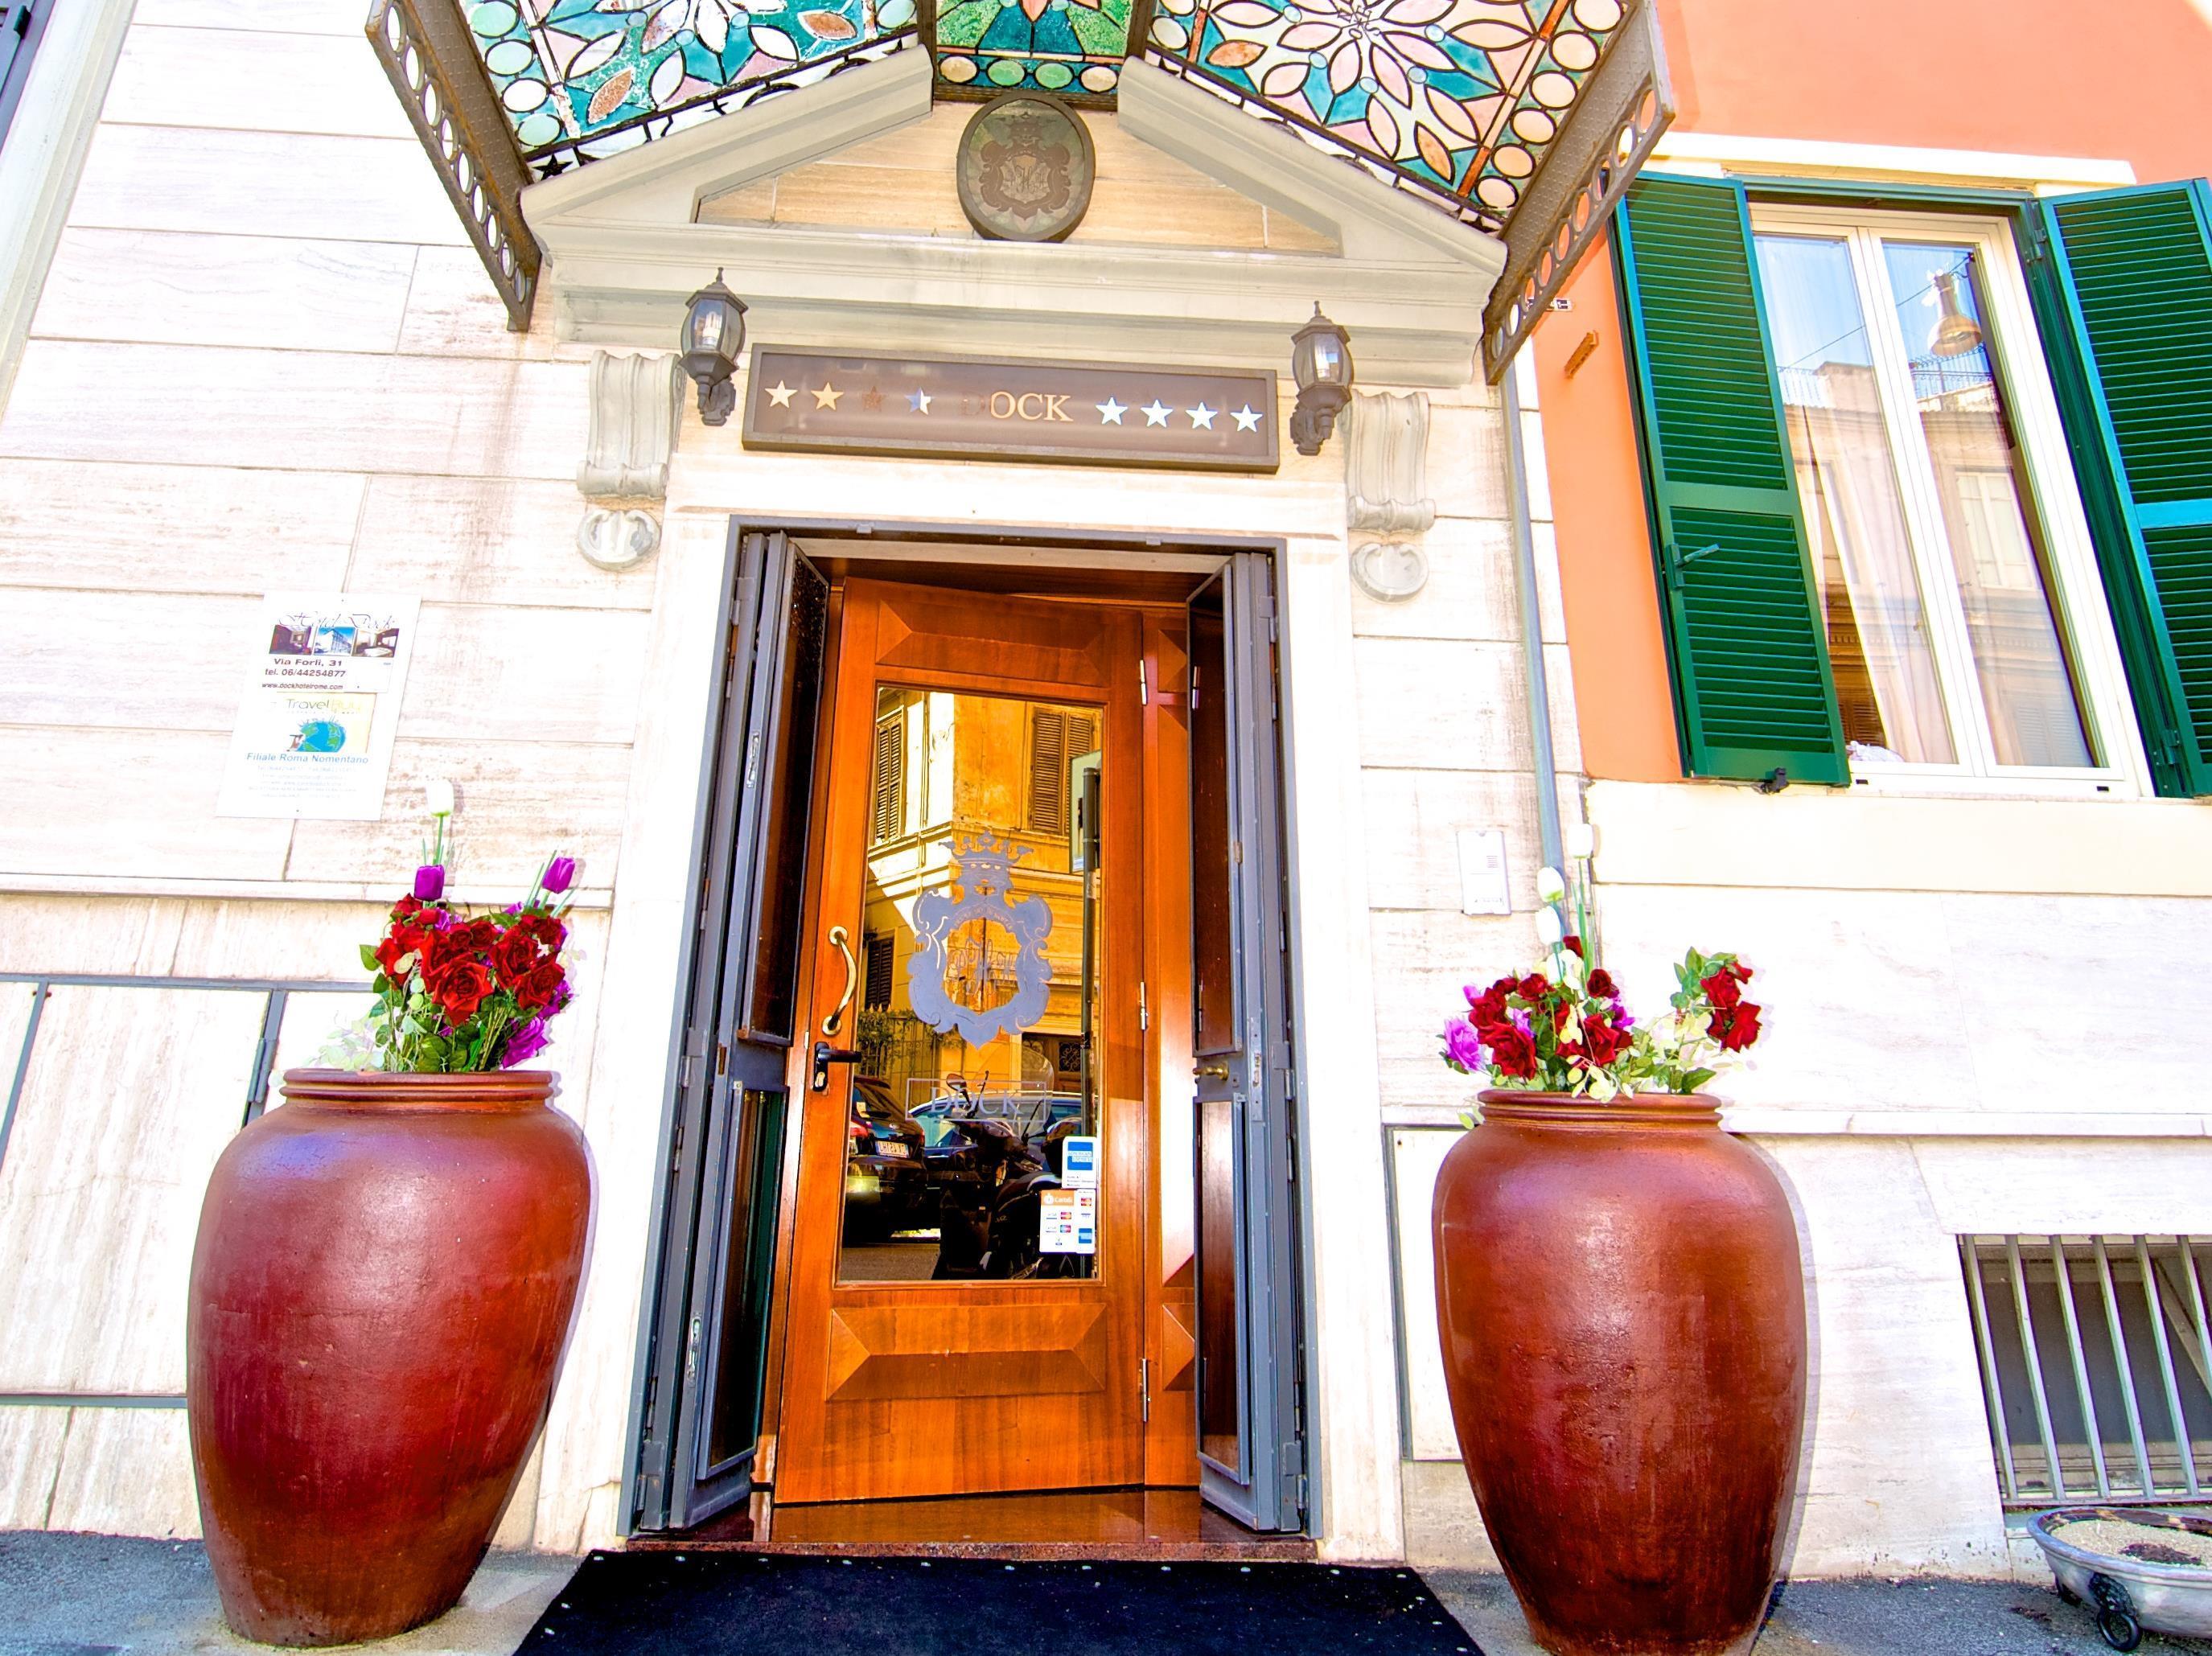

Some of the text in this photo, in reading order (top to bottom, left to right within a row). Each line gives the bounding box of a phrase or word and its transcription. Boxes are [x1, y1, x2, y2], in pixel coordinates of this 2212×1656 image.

[282, 669, 346, 677] 06/44254877
[246, 752, 368, 763] Filiale Roma Nomentano
